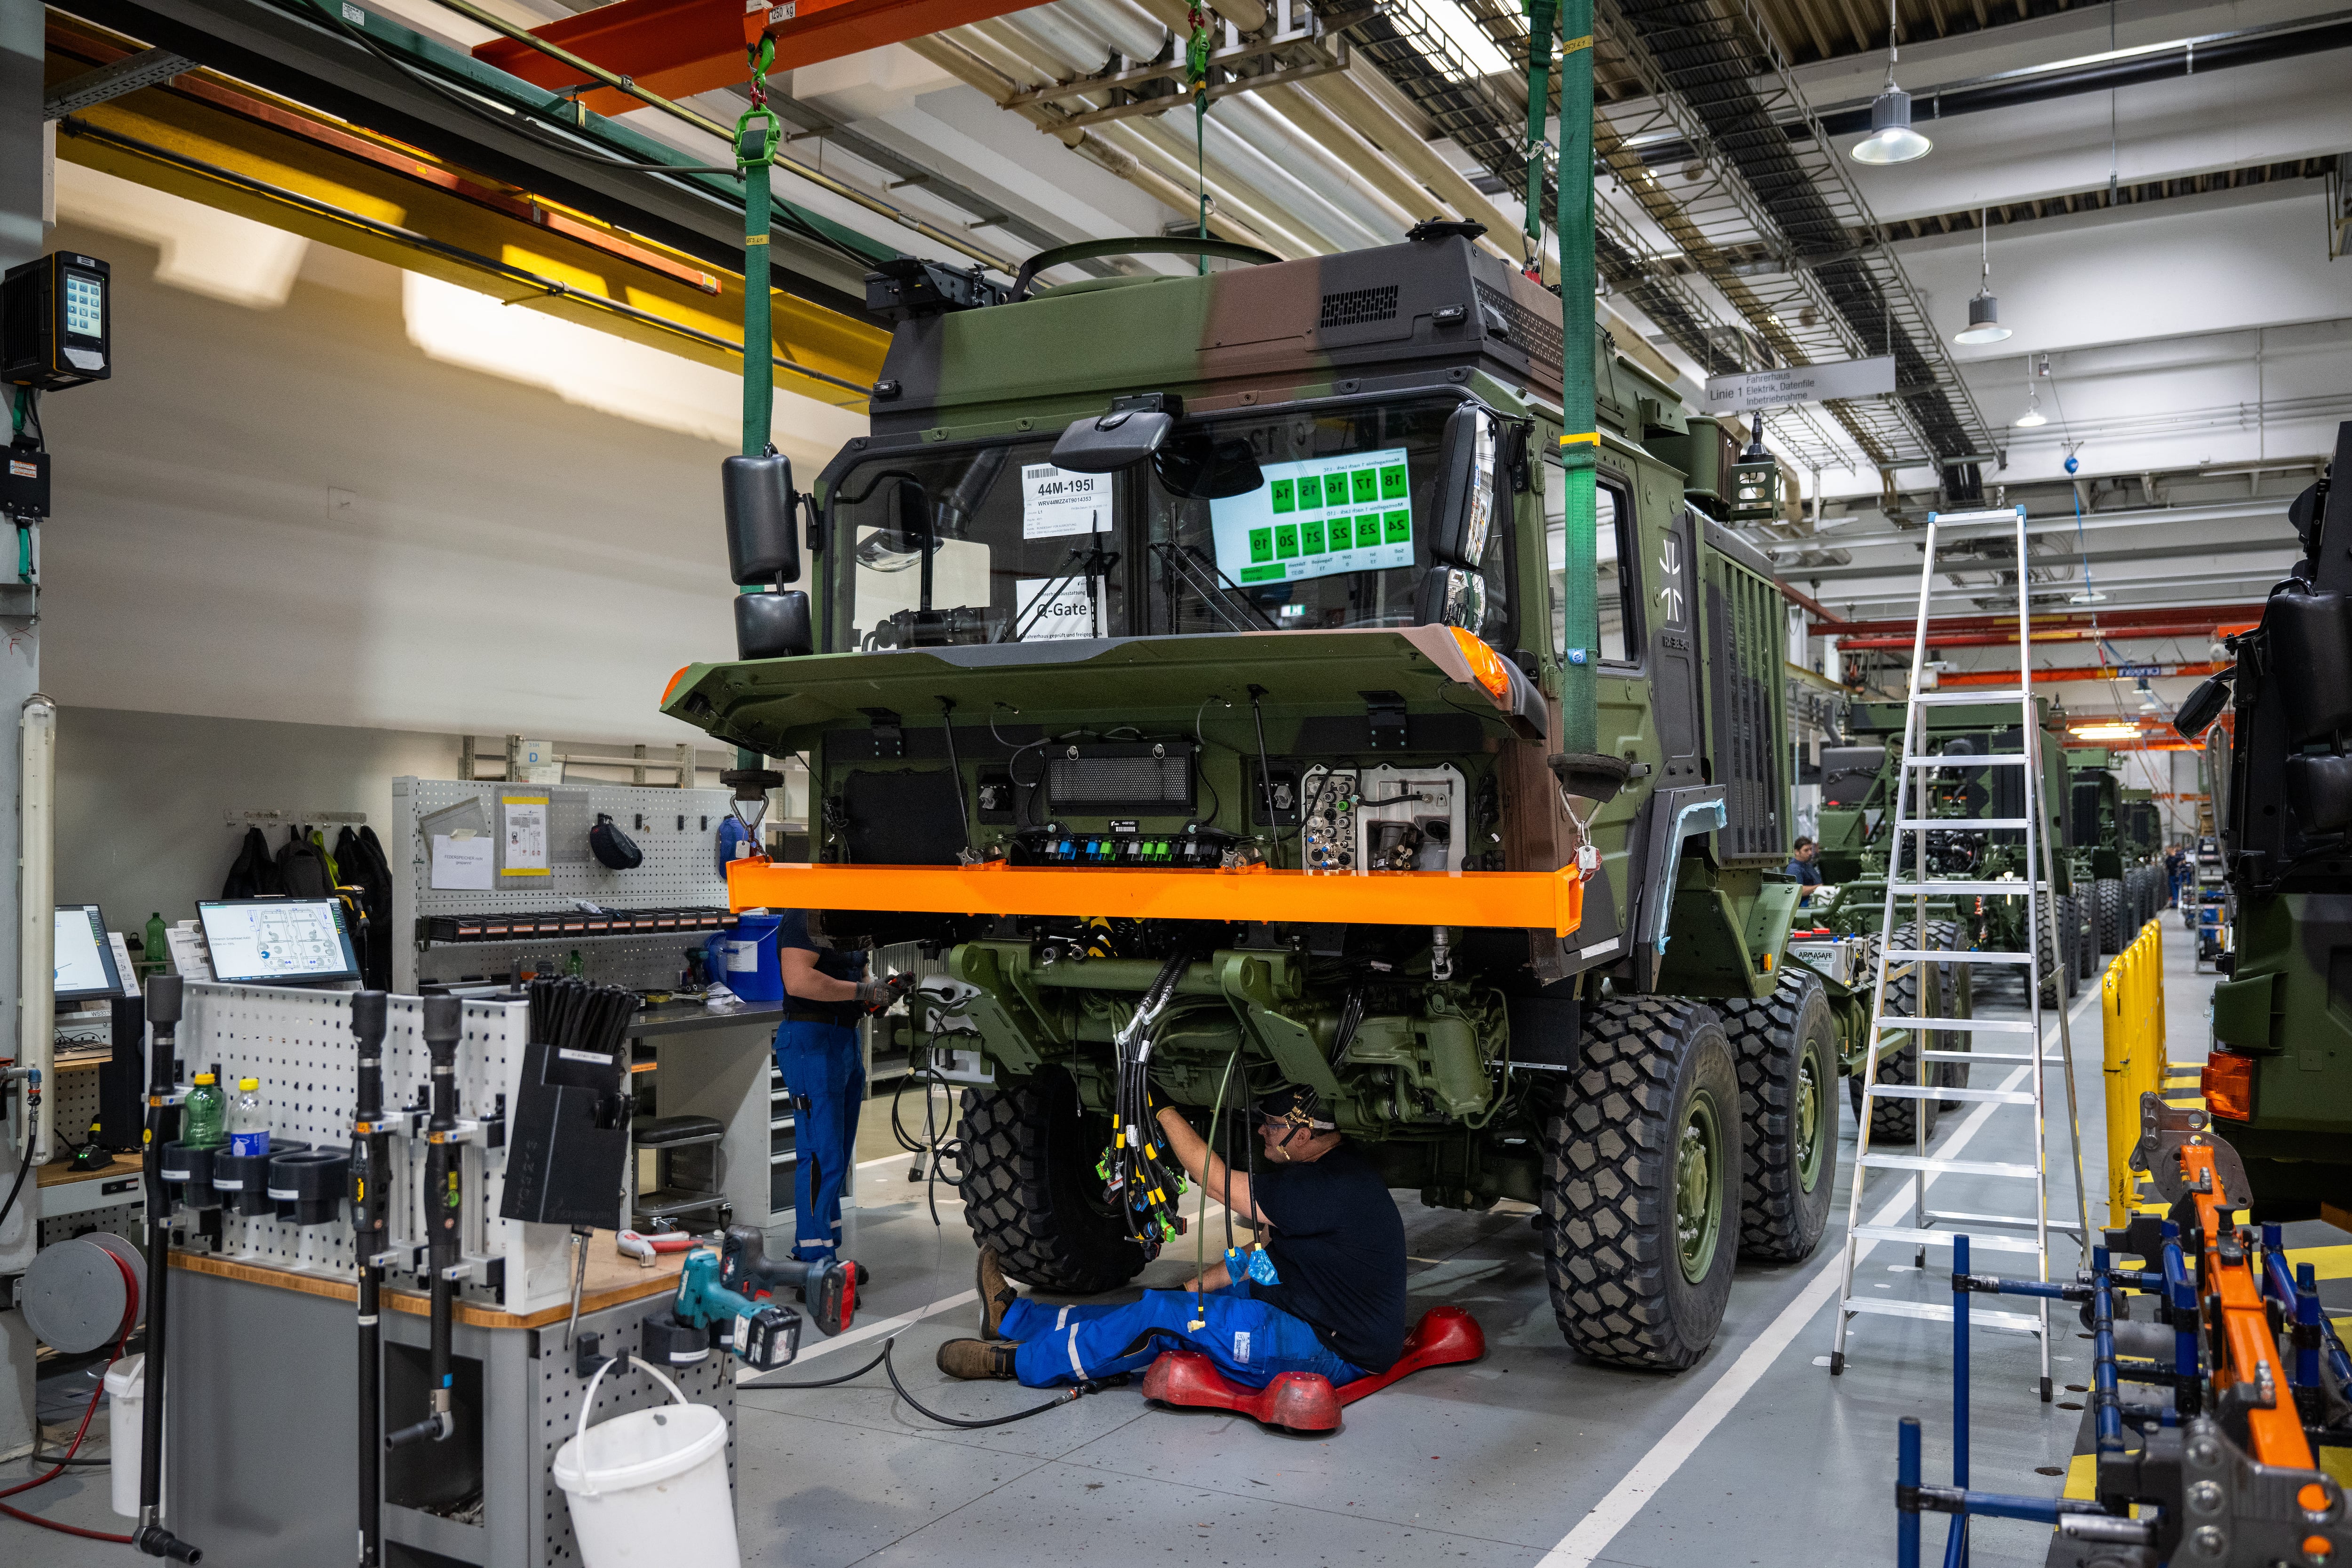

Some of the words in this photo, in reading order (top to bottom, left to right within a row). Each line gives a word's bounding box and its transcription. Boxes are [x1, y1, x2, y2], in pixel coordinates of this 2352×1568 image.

[771, 7, 783, 19] 1250
[787, 5, 793, 17] kg
[1747, 373, 1790, 384] Fahrerhaus
[1710, 389, 1733, 400] Linie
[1738, 388, 1741, 397] 1
[1747, 384, 1778, 395] Elektrik,
[1780, 380, 1815, 391] Datenfile
[1747, 392, 1807, 406] Inbetriebnahme
[1038, 479, 1094, 495] 44M-195I
[1038, 497, 1091, 506] WRV44MZZ4T9014353
[1037, 603, 1087, 619] Q-Gate
[529, 752, 538, 762] D
